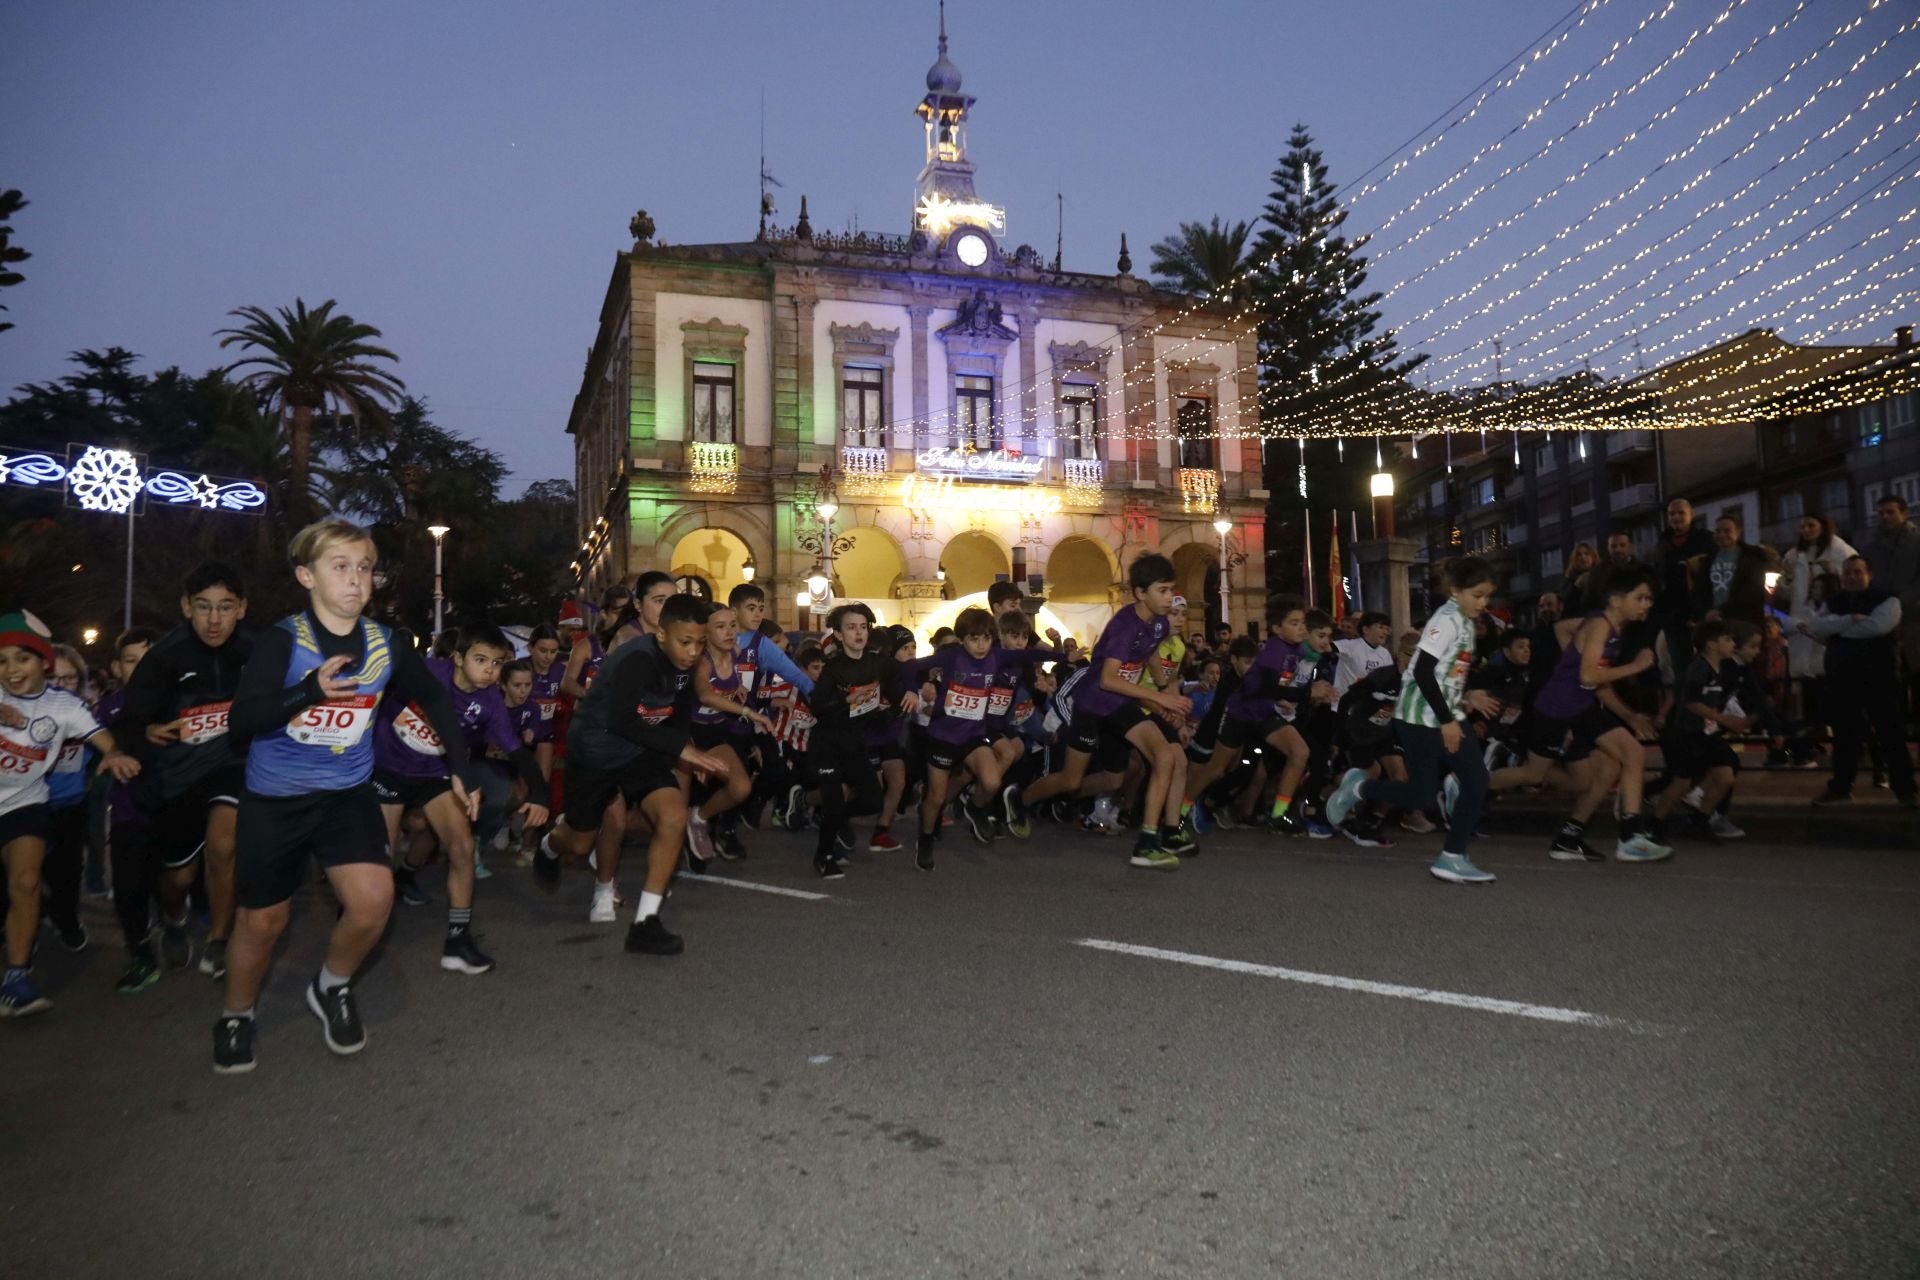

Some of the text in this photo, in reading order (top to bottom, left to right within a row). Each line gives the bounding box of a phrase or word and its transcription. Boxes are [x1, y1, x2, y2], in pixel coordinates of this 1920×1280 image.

[953, 694, 980, 710] 513
[191, 713, 229, 733] 558
[304, 707, 354, 729] 510
[313, 726, 341, 734] DIEGO
[404, 718, 442, 747] 489
[0, 754, 34, 774] 03
